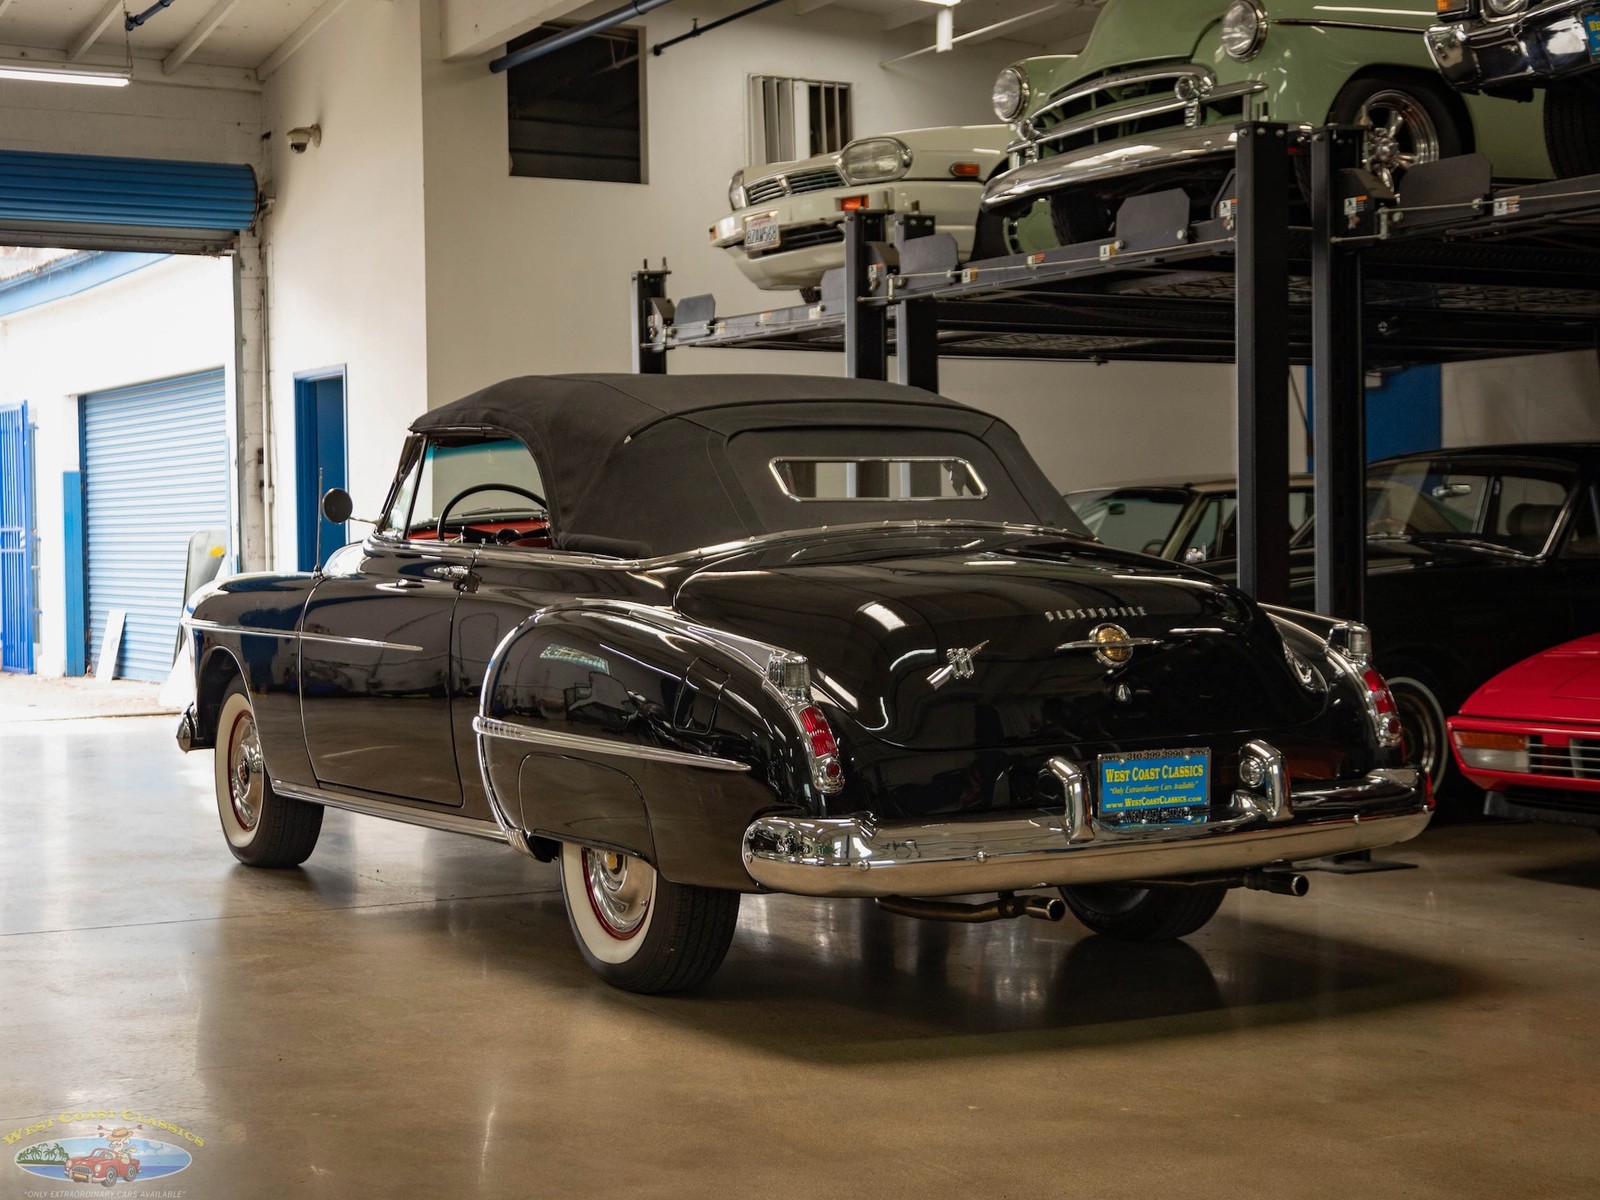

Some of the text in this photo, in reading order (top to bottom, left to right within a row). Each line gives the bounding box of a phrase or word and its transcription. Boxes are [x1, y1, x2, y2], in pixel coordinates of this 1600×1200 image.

[1106, 765, 1203, 782] WEST COAST CLASSICS
[1125, 784, 1160, 794] Extraordinary
